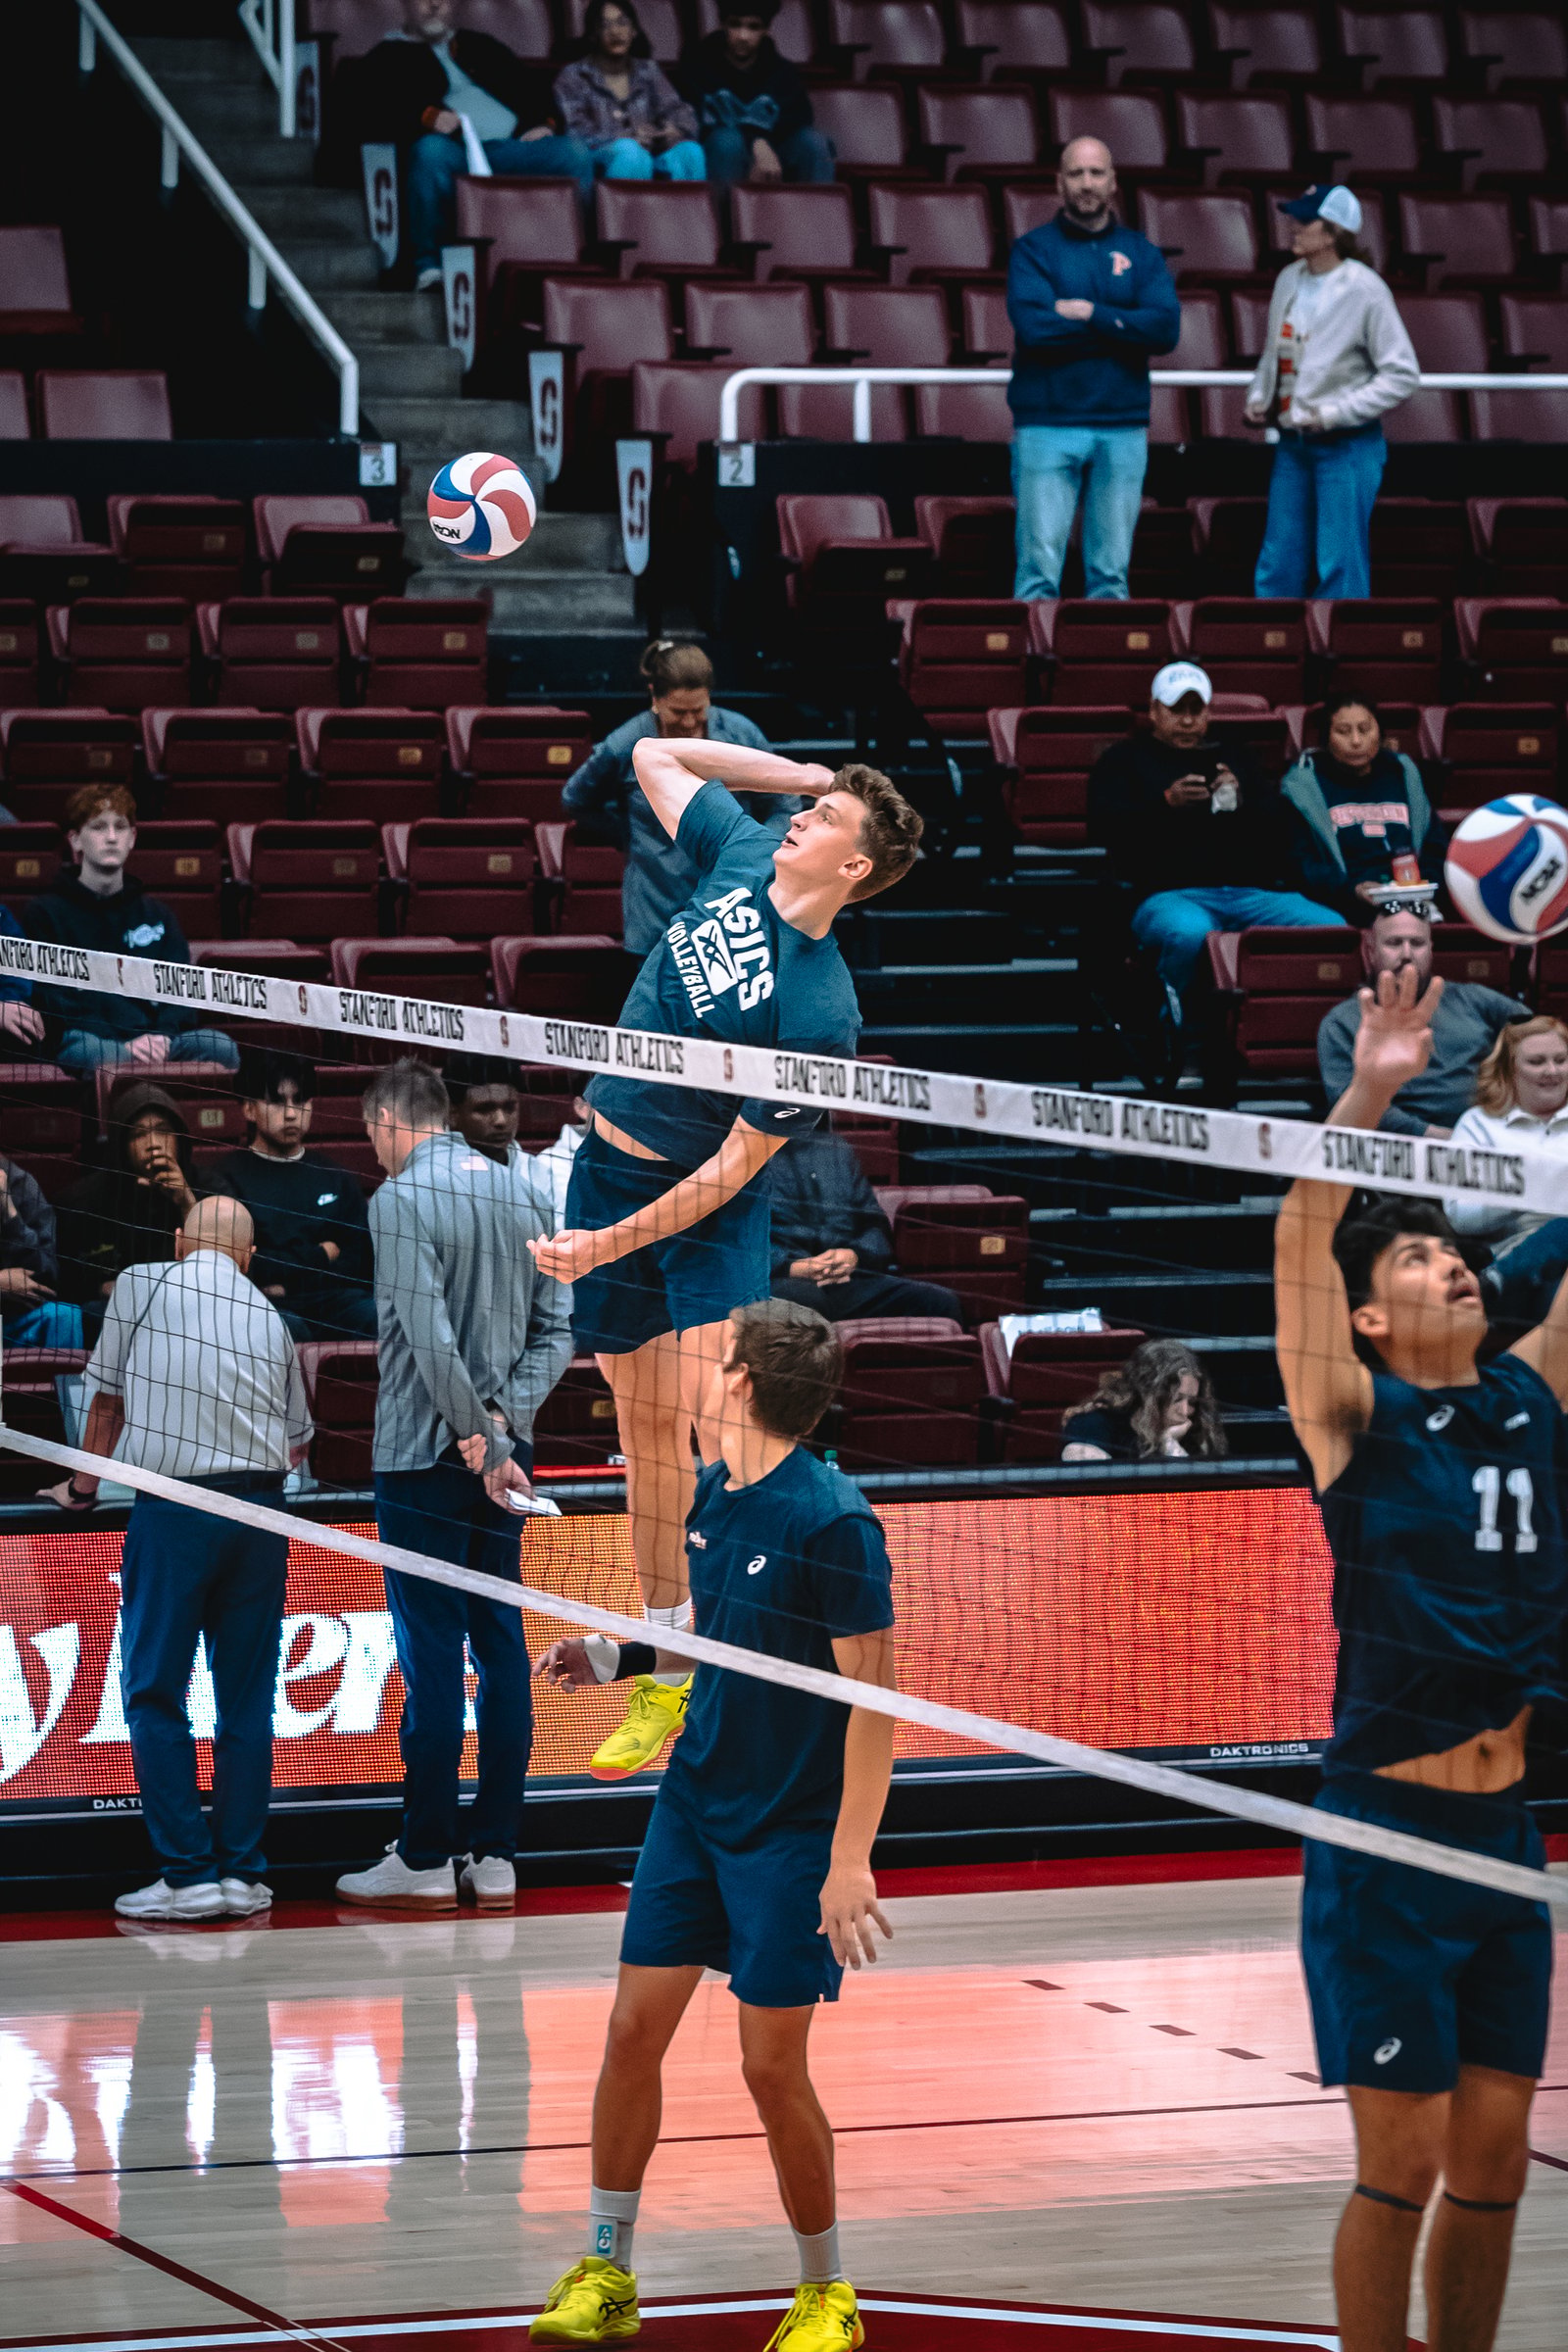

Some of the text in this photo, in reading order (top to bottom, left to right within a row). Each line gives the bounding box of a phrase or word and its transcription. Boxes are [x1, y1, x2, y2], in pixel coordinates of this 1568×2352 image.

[1108, 250, 1132, 276] P
[370, 455, 385, 483] 3
[729, 456, 744, 483] 2
[704, 887, 774, 1011] ASICS
[666, 921, 715, 1018] VOLLEYBALL
[37, 944, 90, 981] ATHLETICS
[153, 963, 207, 1000] STANFORD
[211, 971, 268, 1009] ATHLETICS
[339, 991, 399, 1030] STANFORD
[402, 1000, 465, 1041] ATHLETICS
[545, 1022, 610, 1063] STANFORD
[615, 1032, 684, 1074] ATHLETICS
[774, 1055, 847, 1099] STANFORD
[852, 1065, 931, 1110] ATHLETICS
[1031, 1091, 1113, 1137] STANFORD
[1120, 1102, 1209, 1151] ATHLETICS
[1322, 1130, 1416, 1180] STANFORD
[1425, 1144, 1525, 1196] ATHLETICS
[1471, 1465, 1539, 1553] 11
[1209, 1742, 1309, 1757] DAKTRONICS
[92, 1797, 143, 1810] DAKT
